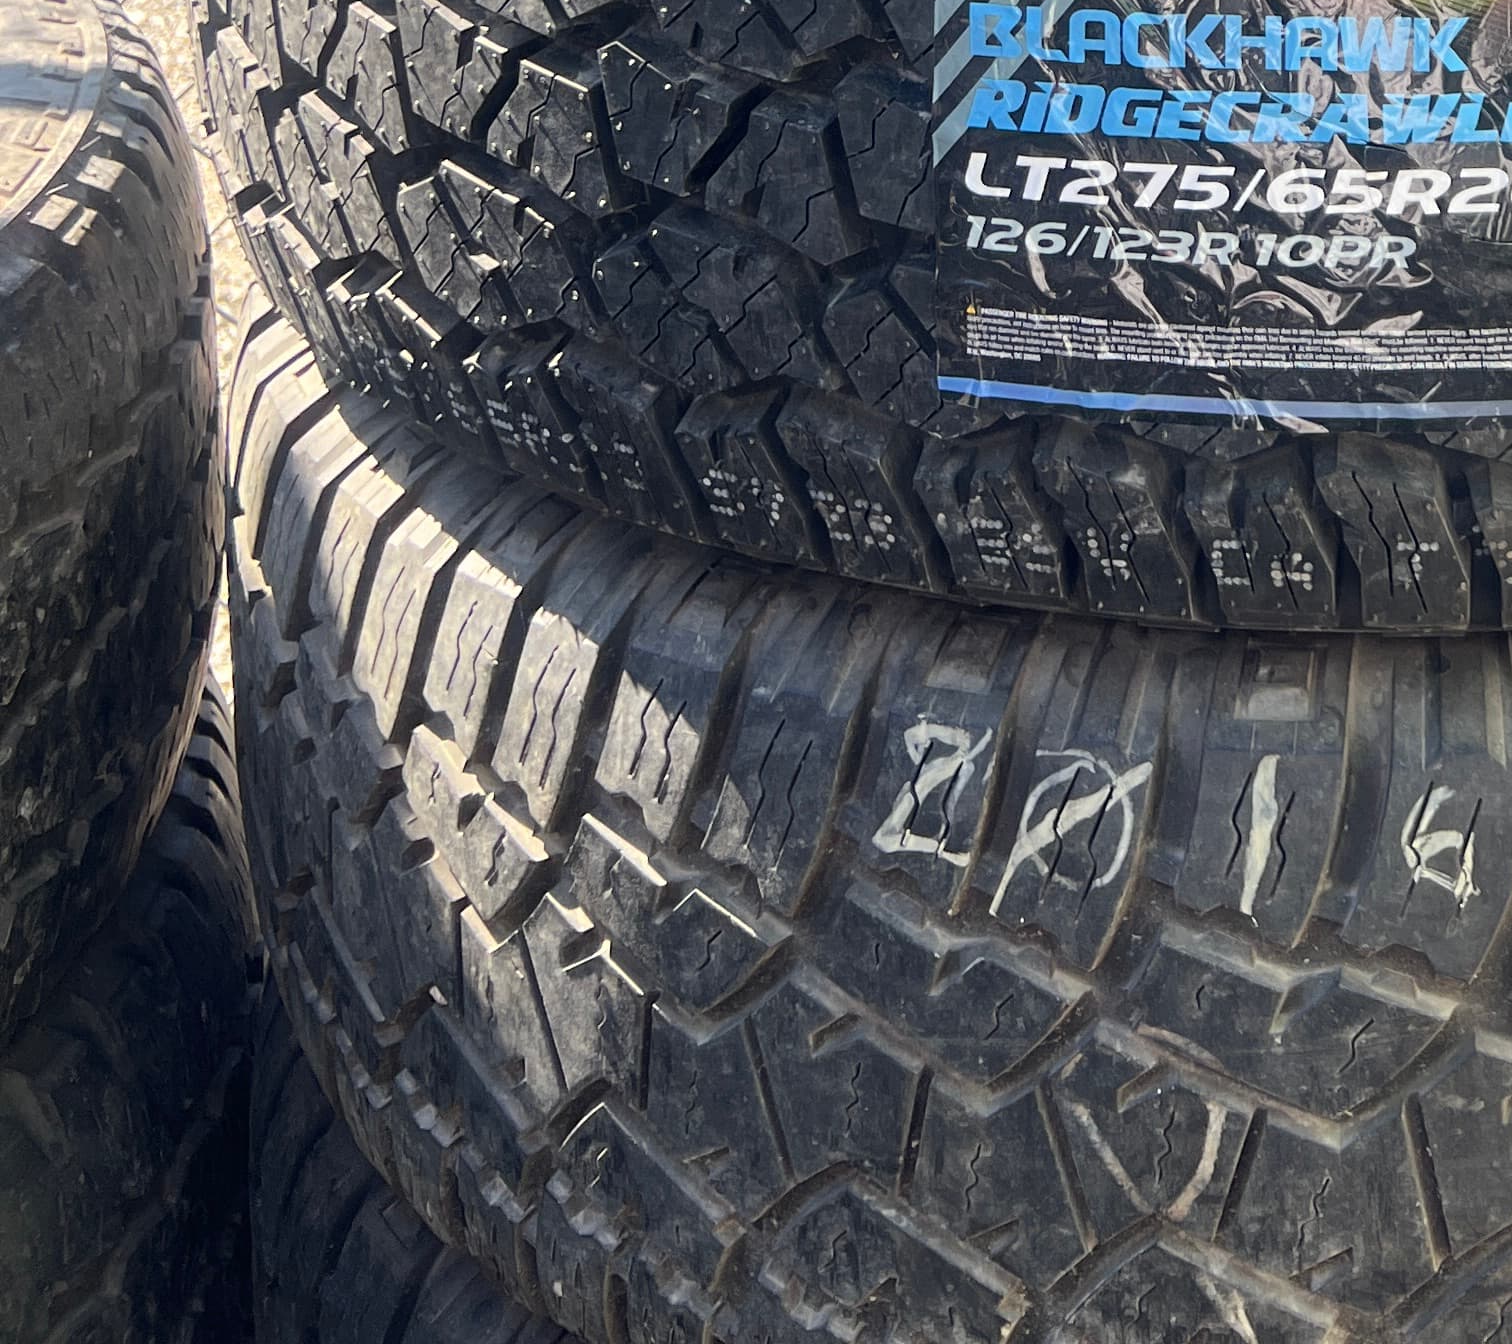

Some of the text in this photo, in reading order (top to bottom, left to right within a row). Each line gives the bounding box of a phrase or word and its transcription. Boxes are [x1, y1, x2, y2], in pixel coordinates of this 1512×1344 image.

[966, 2, 1472, 76] BLACKHAWK
[964, 215, 1418, 272] 126/123R 10PR
